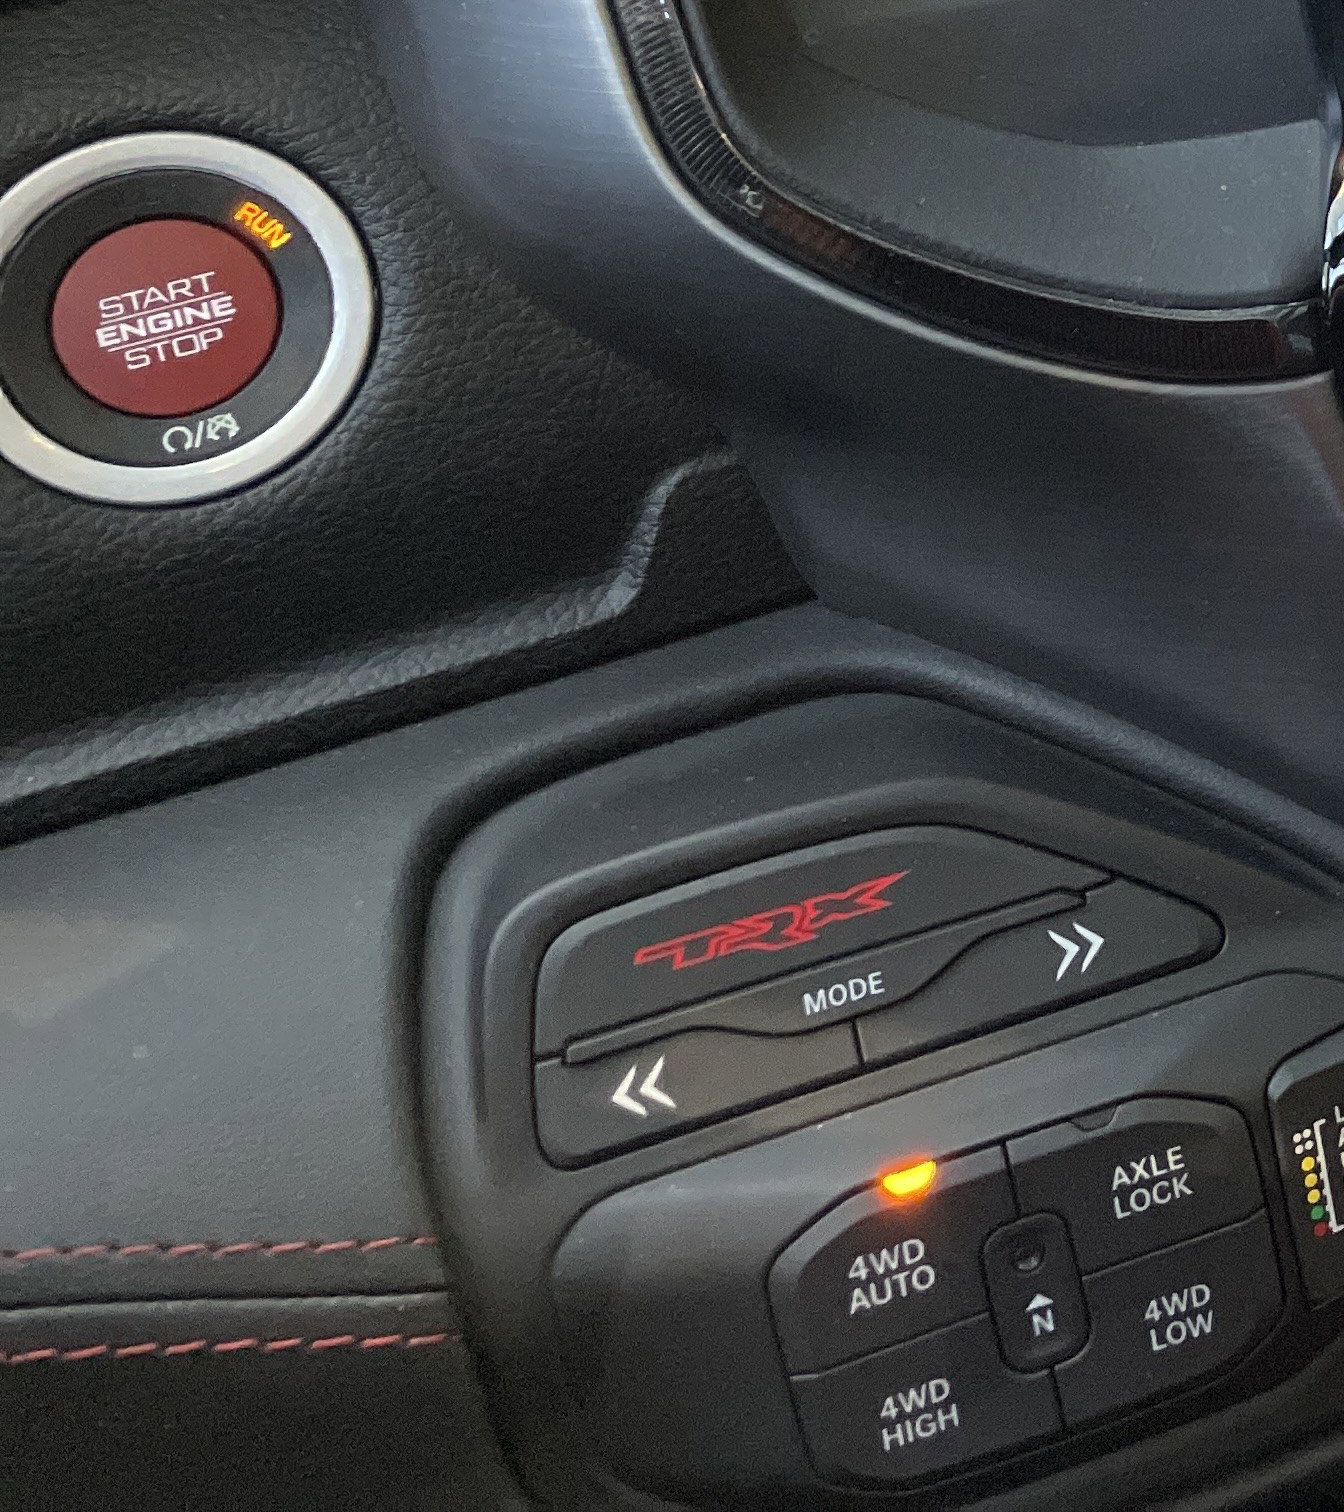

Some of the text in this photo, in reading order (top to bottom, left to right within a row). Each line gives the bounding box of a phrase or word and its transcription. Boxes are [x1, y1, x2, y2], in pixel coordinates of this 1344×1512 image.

[233, 201, 292, 249] RUN
[99, 271, 215, 319] START
[95, 295, 237, 348] ENGINE
[124, 327, 223, 370] STOP
[634, 870, 909, 970] TRX
[803, 972, 885, 1016] MODE
[1111, 1148, 1186, 1192] AXLE
[1113, 1172, 1193, 1220] LOCK
[848, 1238, 926, 1284] 4WD
[849, 1264, 937, 1315] AUTO
[1144, 1284, 1211, 1325] 4WD
[1032, 1309, 1055, 1336] N
[1148, 1309, 1214, 1353] LOW
[879, 1378, 951, 1423] 4WD
[881, 1404, 960, 1451] HIGH
